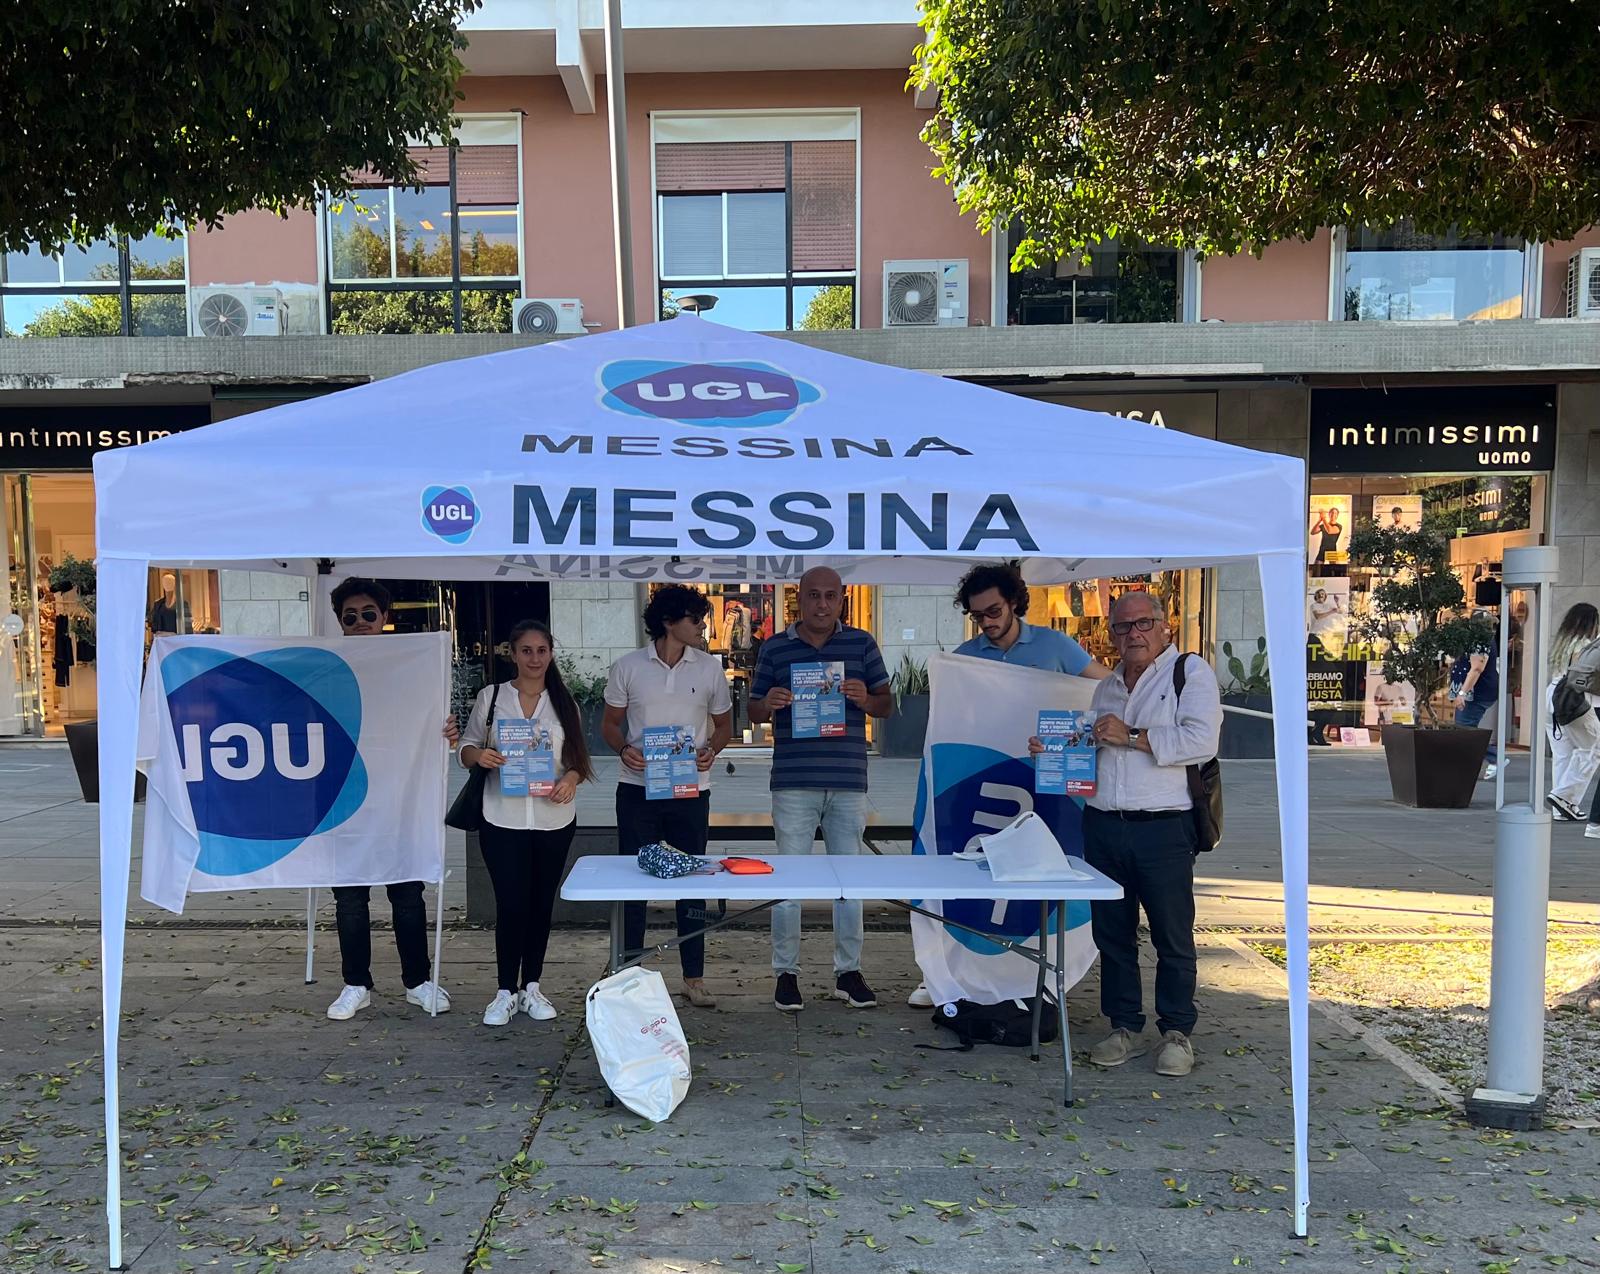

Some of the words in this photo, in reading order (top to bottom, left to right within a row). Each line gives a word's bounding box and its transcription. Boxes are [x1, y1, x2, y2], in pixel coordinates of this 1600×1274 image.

[635, 380, 790, 402] UGL
[0, 428, 184, 447] intimissim
[1329, 423, 1539, 445] intimissimi
[521, 434, 974, 458] MESSINA
[1478, 451, 1531, 464] uomo
[430, 504, 473, 522] UGL
[512, 484, 1040, 552] MESSINA
